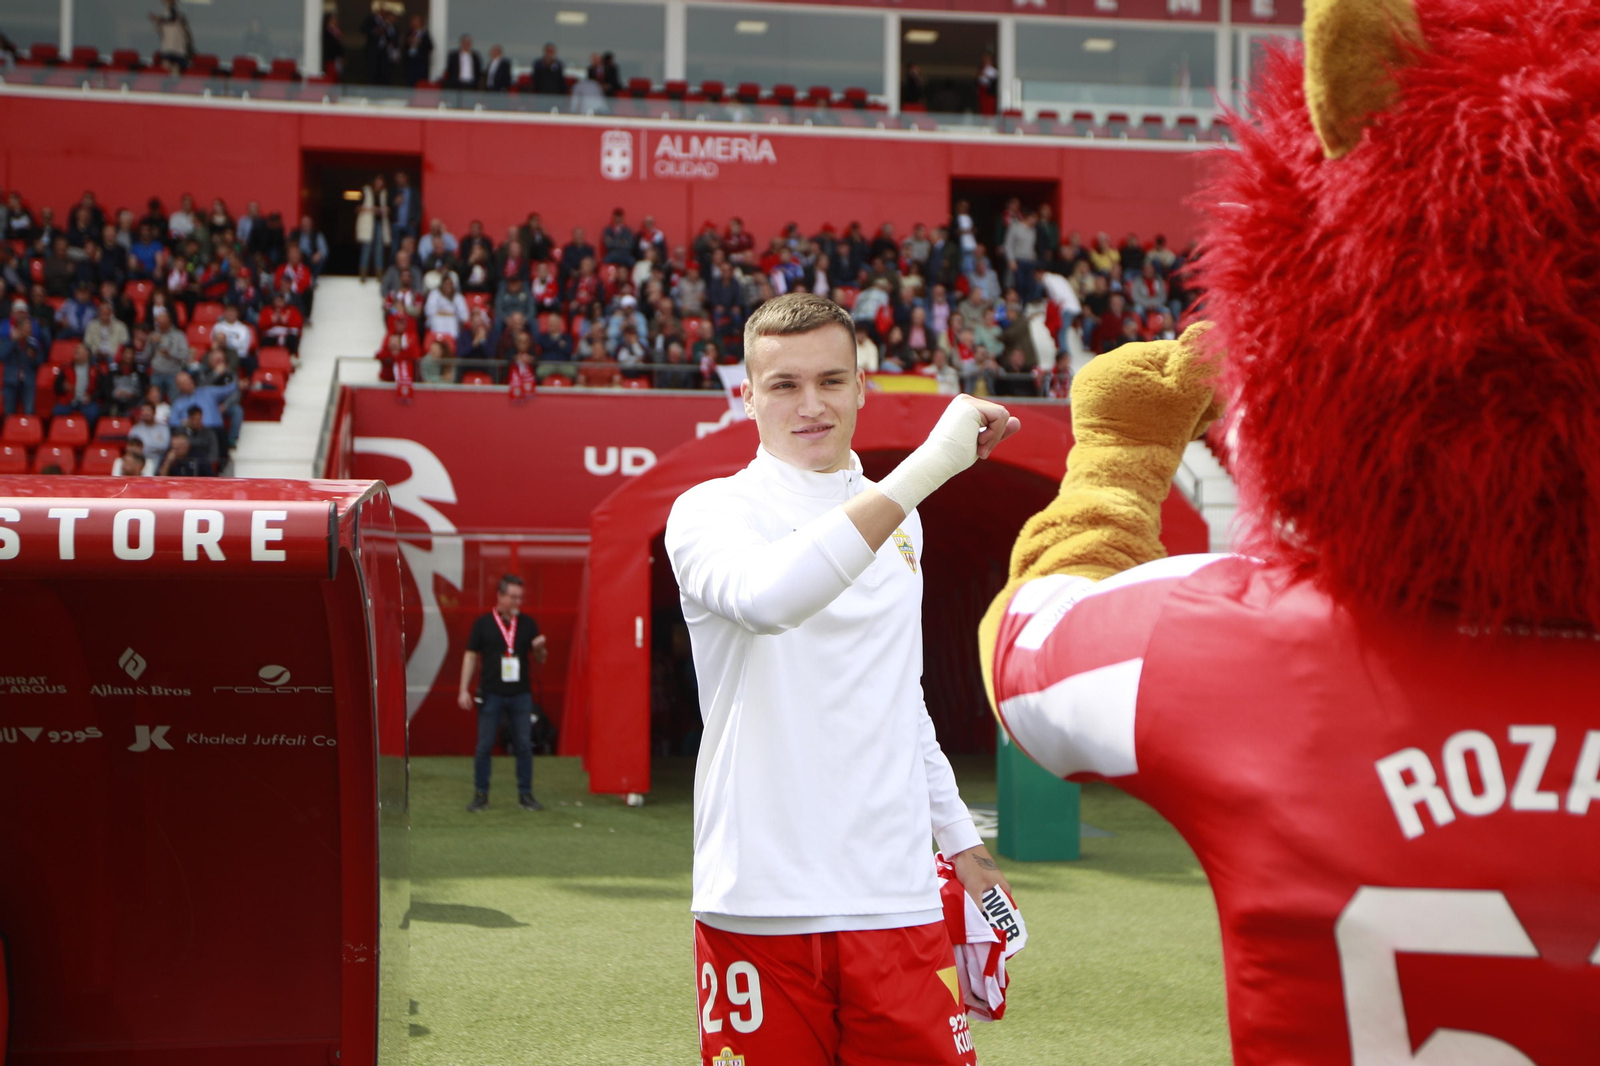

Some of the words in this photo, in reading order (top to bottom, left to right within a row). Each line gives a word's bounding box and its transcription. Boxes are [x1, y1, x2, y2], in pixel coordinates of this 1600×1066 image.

[655, 133, 777, 164] ALMERÍA
[654, 160, 719, 180] CIUDAD
[10, 685, 67, 694] AROUS
[90, 684, 134, 697] Ajlan
[136, 686, 148, 696] &
[151, 685, 191, 696] Bros
[186, 733, 247, 745] Khaled
[253, 734, 306, 746] Juffali
[702, 960, 764, 1033] 29
